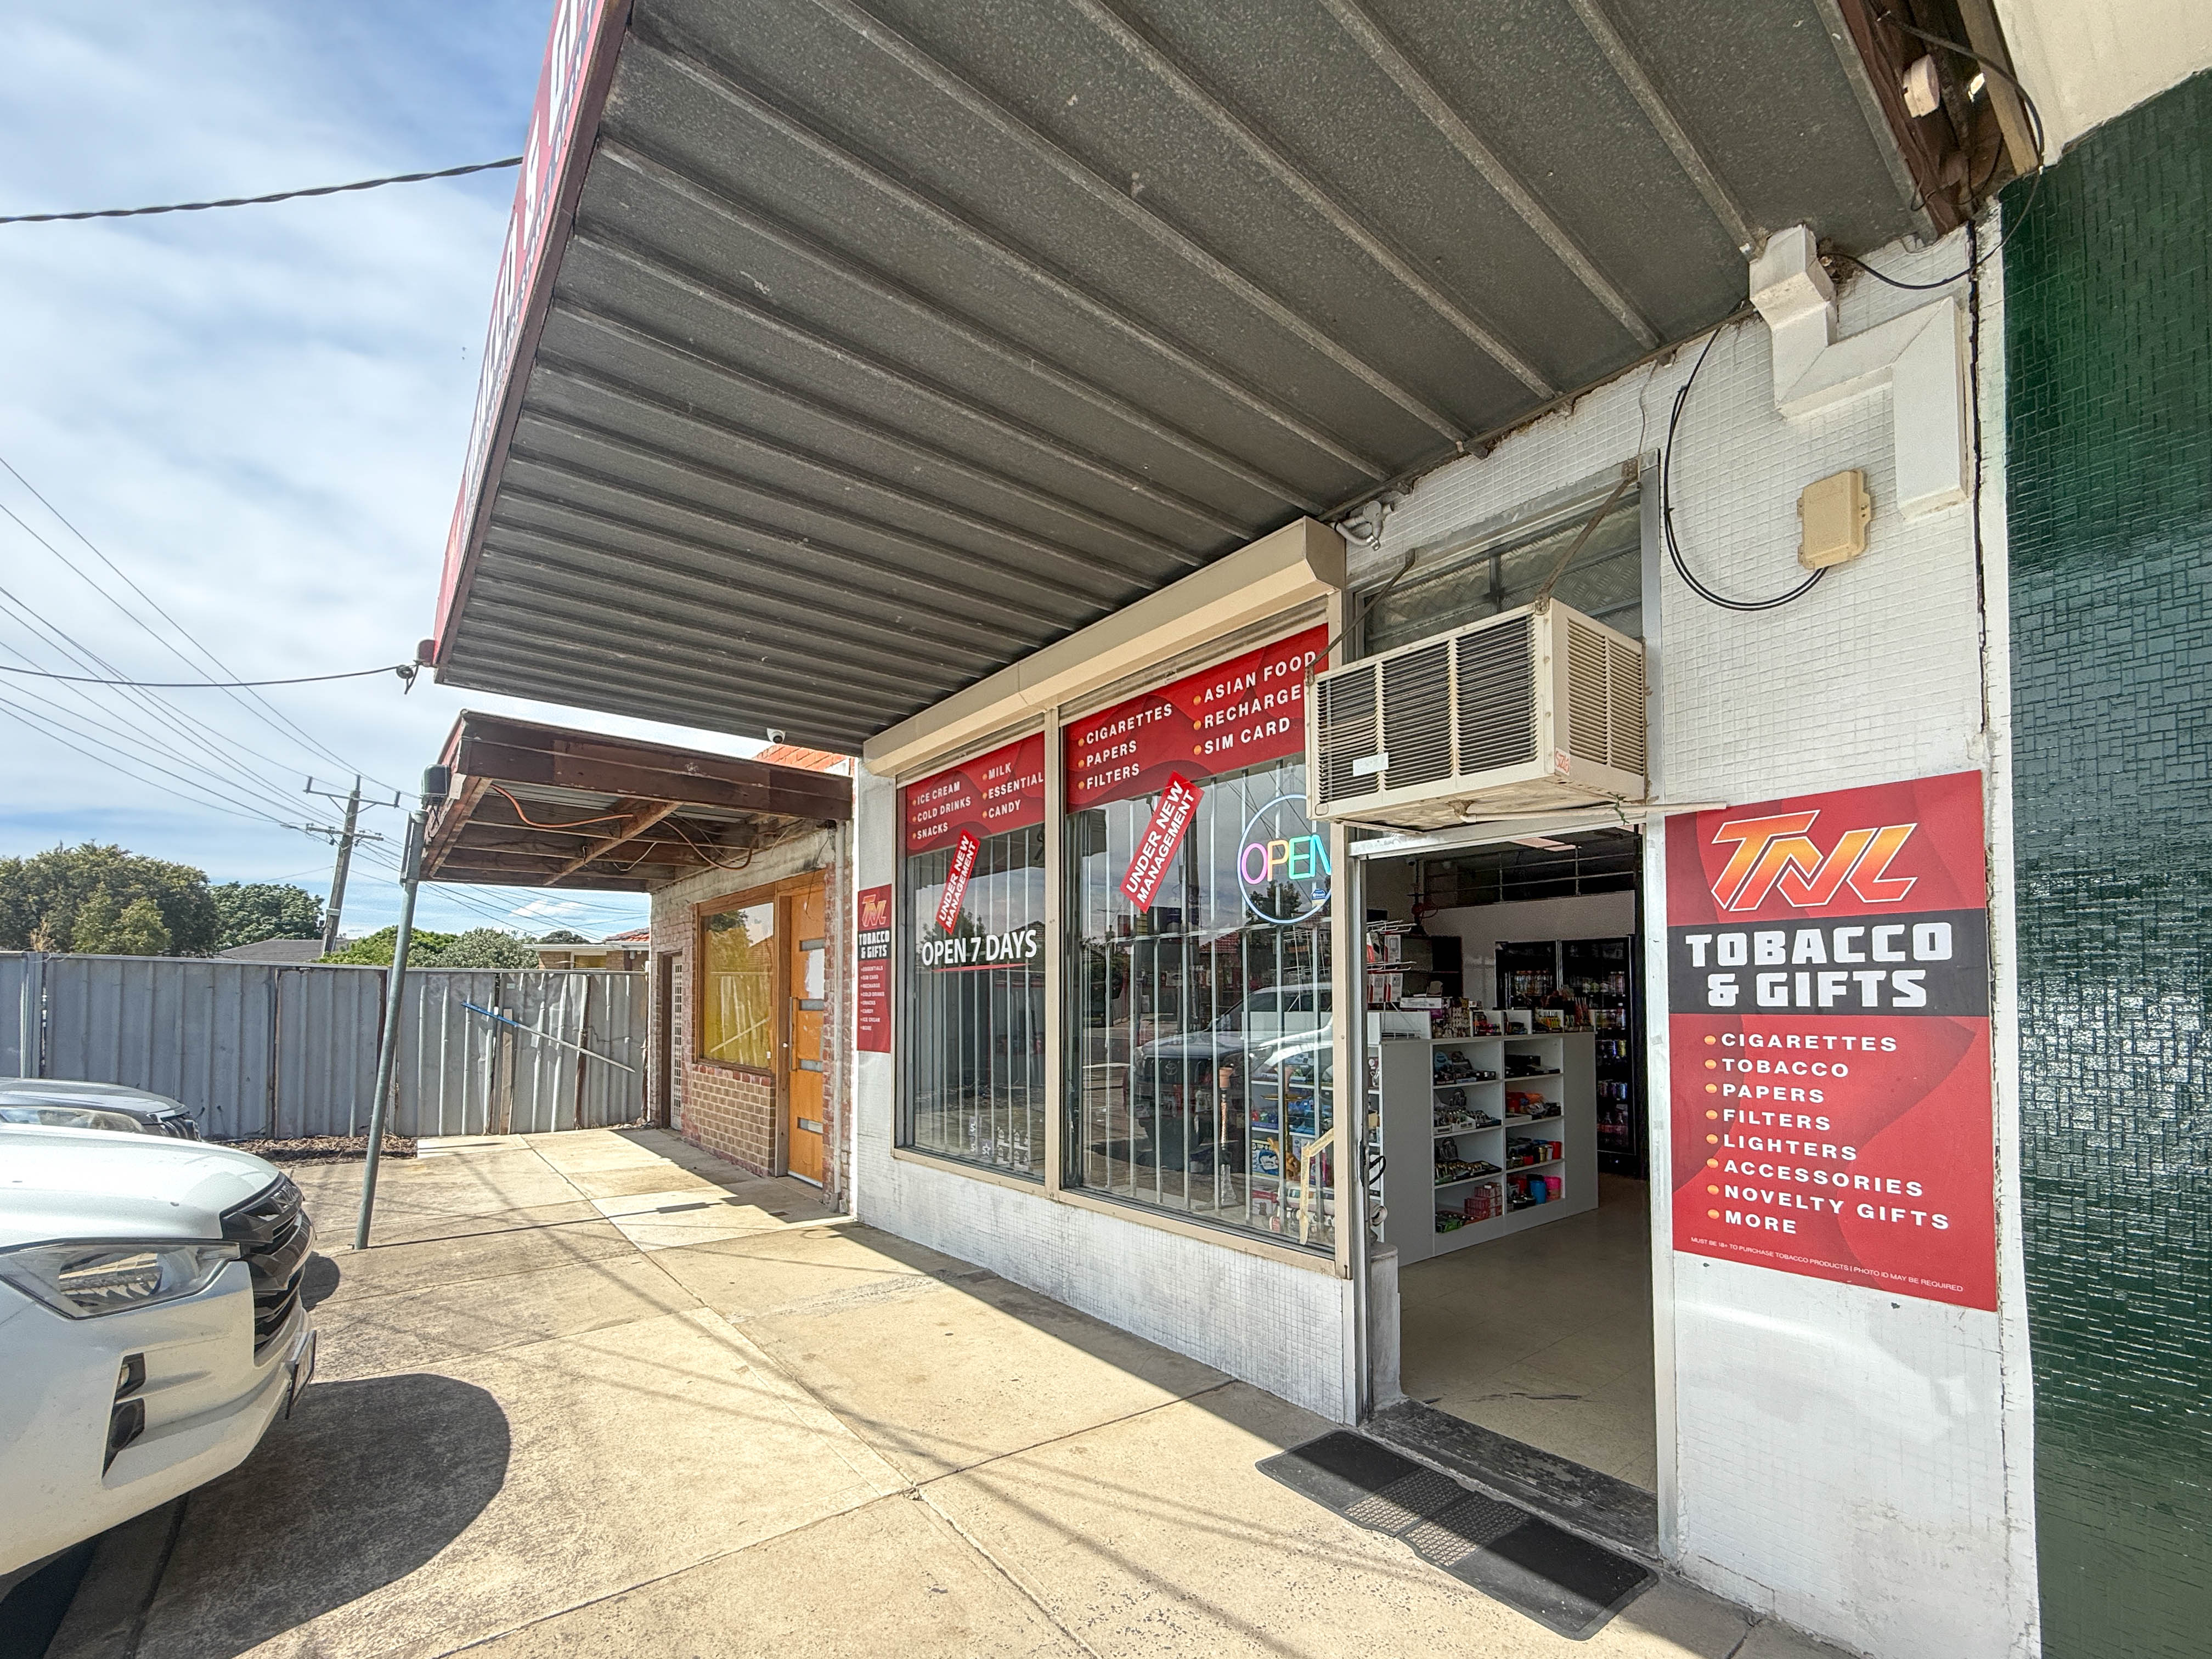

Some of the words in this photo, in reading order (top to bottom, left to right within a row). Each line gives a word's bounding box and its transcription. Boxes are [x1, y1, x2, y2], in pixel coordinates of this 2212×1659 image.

[1204, 672, 1256, 703] ASIAN
[1264, 651, 1316, 681] FOOD
[1087, 703, 1172, 744] CIGARETTES
[1204, 684, 1301, 729] RECHARGE
[1087, 740, 1136, 767] PAPERS
[1204, 733, 1233, 754] SIM
[1240, 717, 1290, 743] CARD
[988, 763, 1011, 780] MILK
[1087, 763, 1139, 789] FILTERS
[917, 794, 930, 805] ICE
[932, 781, 961, 802] CREAM
[917, 808, 938, 822] COLD
[940, 797, 971, 815] DRINKS
[988, 799, 1021, 819] CANDY
[917, 822, 948, 839] SNACKS
[1126, 826, 1161, 894] UNDER
[1155, 780, 1183, 832] NEW
[1136, 789, 1193, 904] MANAGEMENT
[1241, 834, 1331, 884] OPEN
[1711, 809, 1918, 913] TNL
[939, 873, 957, 921] UNDER
[953, 836, 969, 878] NEW
[945, 840, 975, 928] MANAGEMENT
[859, 930, 890, 946] TOBACCO
[861, 946, 867, 959] &
[867, 945, 887, 958] GIFTS
[922, 939, 967, 966] OPEN
[970, 936, 981, 962] 7
[986, 929, 1037, 962] DAYS
[1685, 922, 1953, 967] TOBACCO
[1707, 973, 1739, 1007] &
[1756, 969, 1927, 1007] GIFTS
[1721, 1033, 1897, 1052] CIGARETTES
[1722, 1058, 1849, 1077] TOBACCO
[1723, 1084, 1824, 1103] PAPERS
[1723, 1109, 1830, 1131] FILTERS
[1724, 1133, 1857, 1161] LIGHTERS
[1724, 1160, 1923, 1197] ACCESSORIES
[1725, 1184, 1844, 1214] NOVELTY
[1857, 1204, 1949, 1229] GIFTS
[1725, 1210, 1796, 1234] MORE
[1691, 1237, 1708, 1246] MUST
[1729, 1243, 1739, 1251] TO
[1739, 1244, 1774, 1257] PURCHASE
[1775, 1252, 1809, 1264] TOBACCO
[1809, 1258, 1849, 1271] PRODUCTS
[1853, 1266, 1880, 1277] PHOTO
[1890, 1272, 1907, 1282] MAY
[1920, 1278, 1963, 1292] REQUIRED
